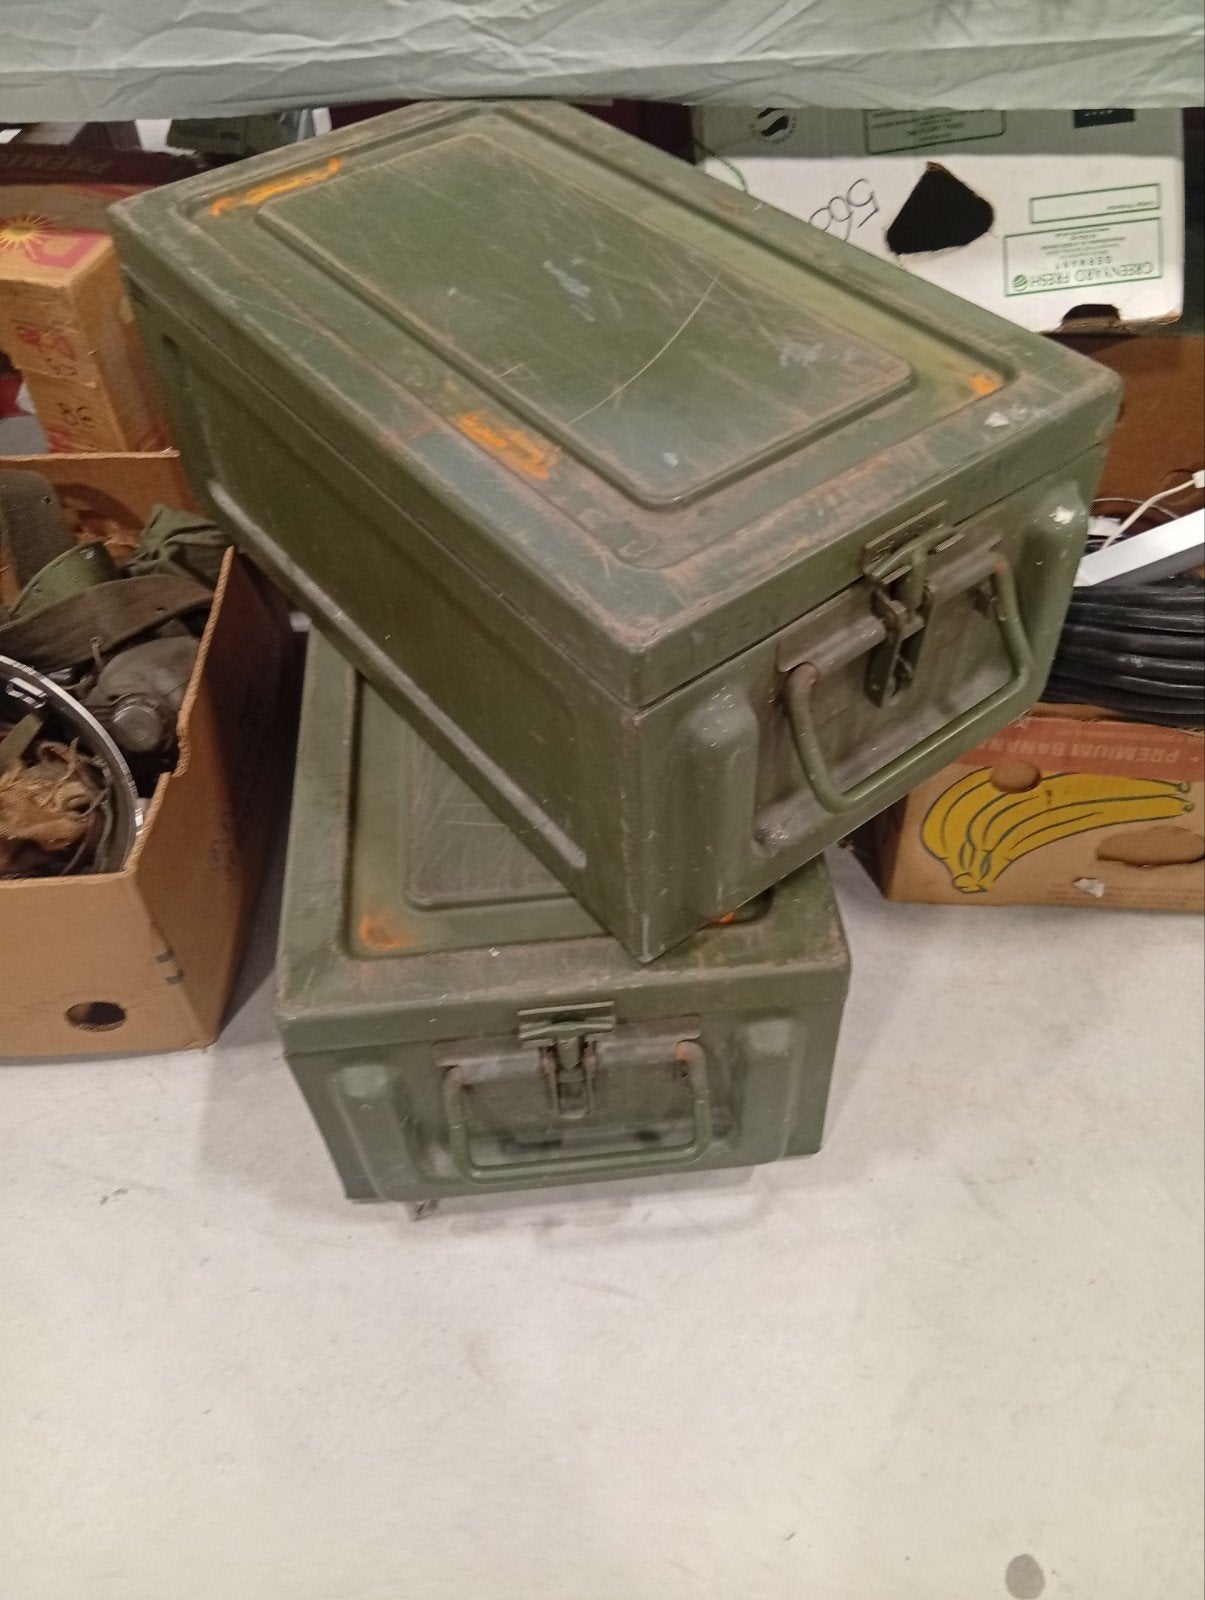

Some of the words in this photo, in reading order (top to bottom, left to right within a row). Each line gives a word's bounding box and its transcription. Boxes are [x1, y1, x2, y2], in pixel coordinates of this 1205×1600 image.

[1030, 271, 1071, 289] FRESH
[1073, 260, 1155, 283] GREENYARD
[979, 738, 1066, 757] BANAN
[1070, 742, 1181, 764] PREMIUM
